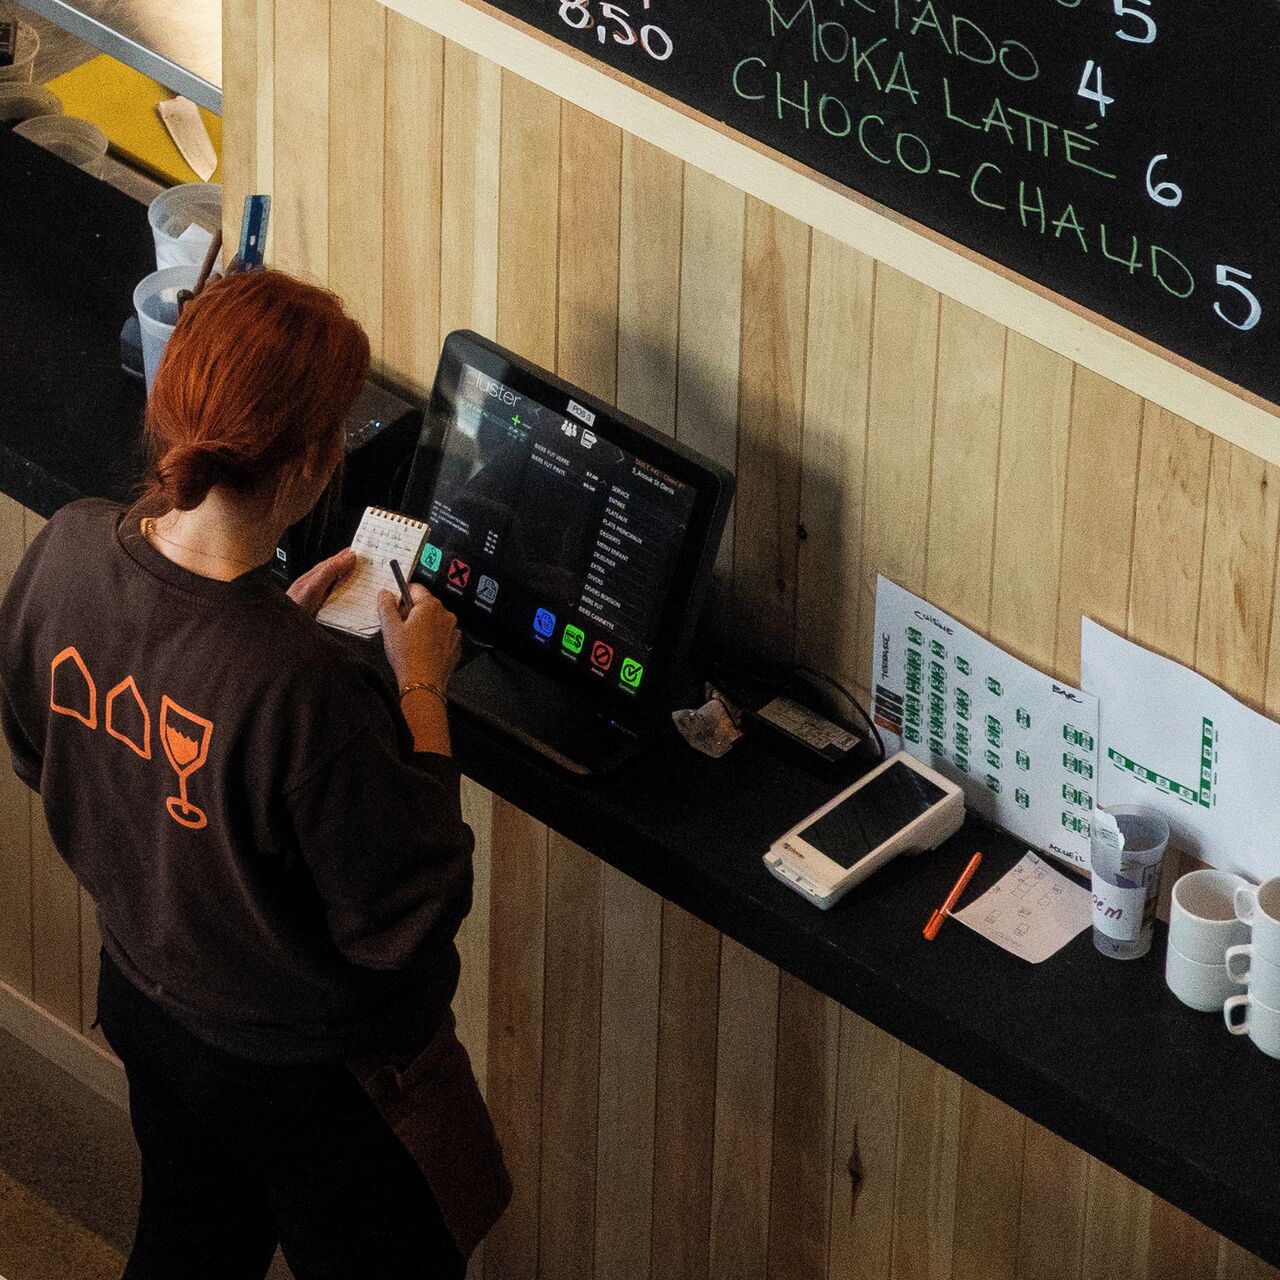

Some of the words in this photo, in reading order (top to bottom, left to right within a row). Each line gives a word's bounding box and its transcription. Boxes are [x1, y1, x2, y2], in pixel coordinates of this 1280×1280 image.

[1078, 60, 1115, 117] 4
[943, 77, 1117, 179] LATTÉ
[1145, 154, 1183, 207] 6
[733, 57, 1194, 298] CHOCO-CHAUD
[1213, 265, 1262, 331] 5
[571, 404, 587, 419] POS
